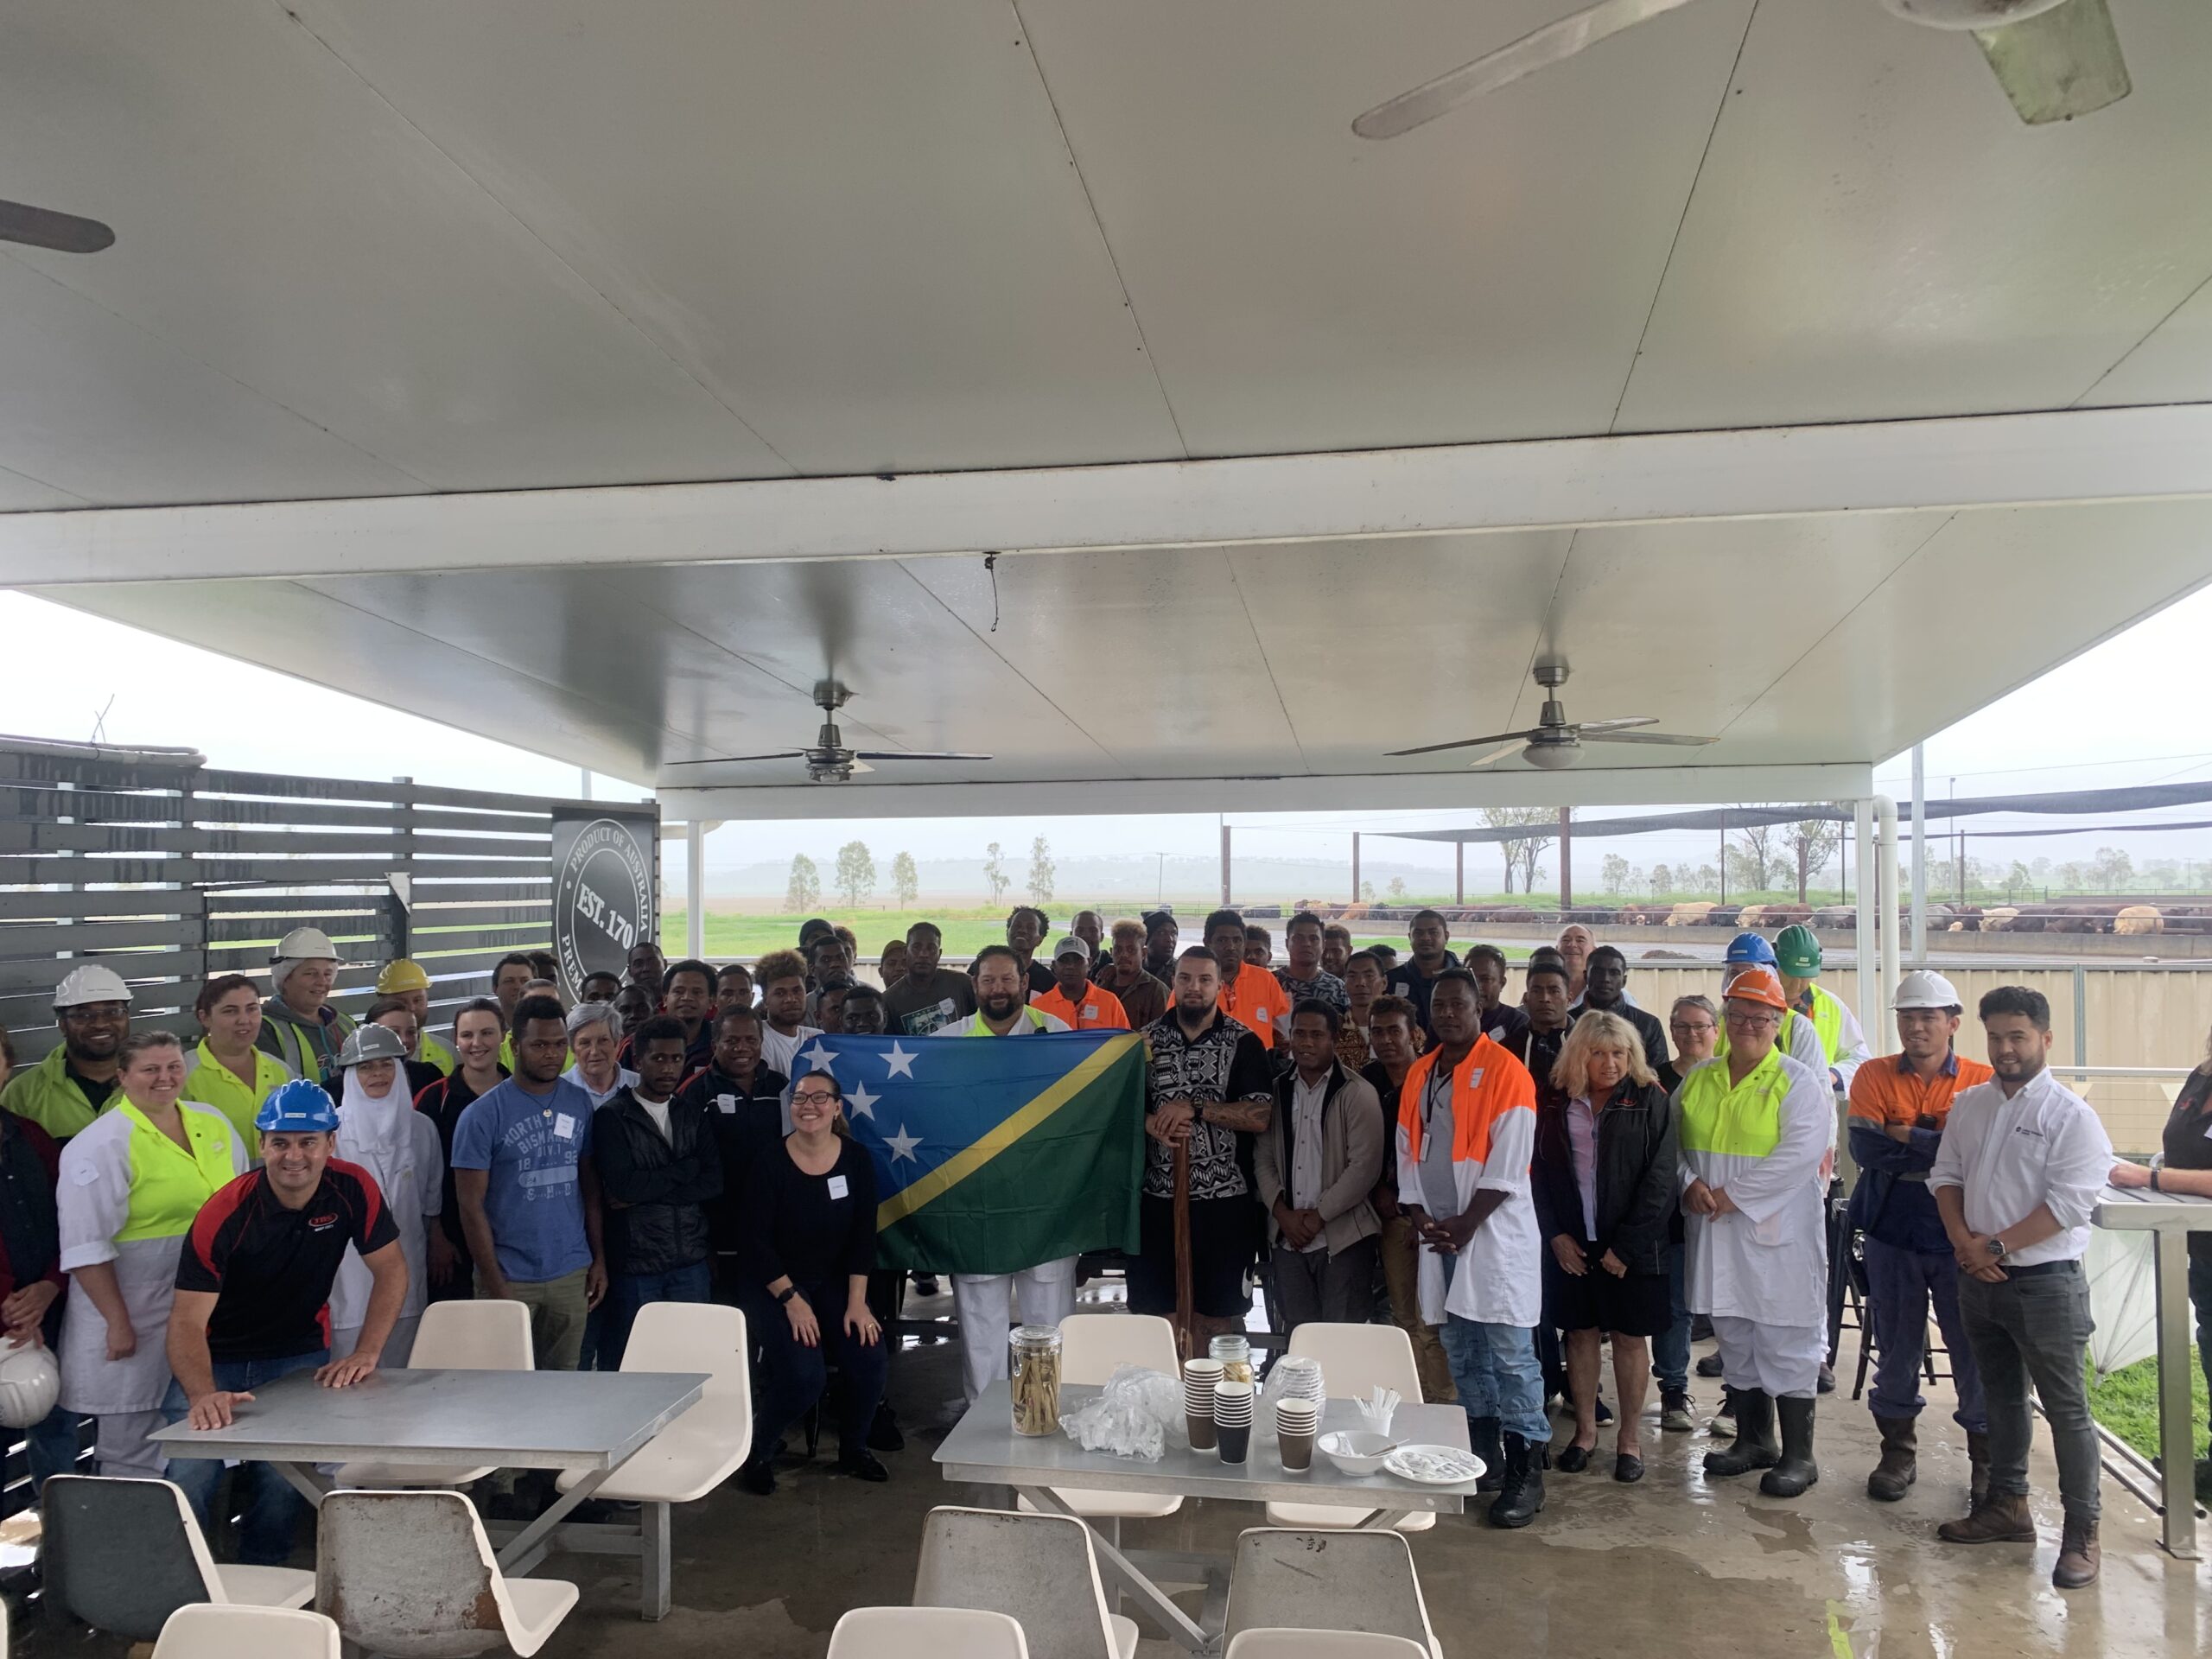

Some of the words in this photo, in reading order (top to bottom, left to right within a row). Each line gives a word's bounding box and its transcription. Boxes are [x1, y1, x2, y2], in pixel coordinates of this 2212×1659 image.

[569, 827, 611, 873] PRODUCT
[613, 830, 625, 848] OF
[624, 844, 648, 932] AUSTRALIA
[576, 882, 605, 929] EST.
[606, 909, 633, 950] 170
[562, 933, 583, 996] PREM
[501, 1114, 543, 1147] NORTH
[518, 1158, 531, 1171] 18
